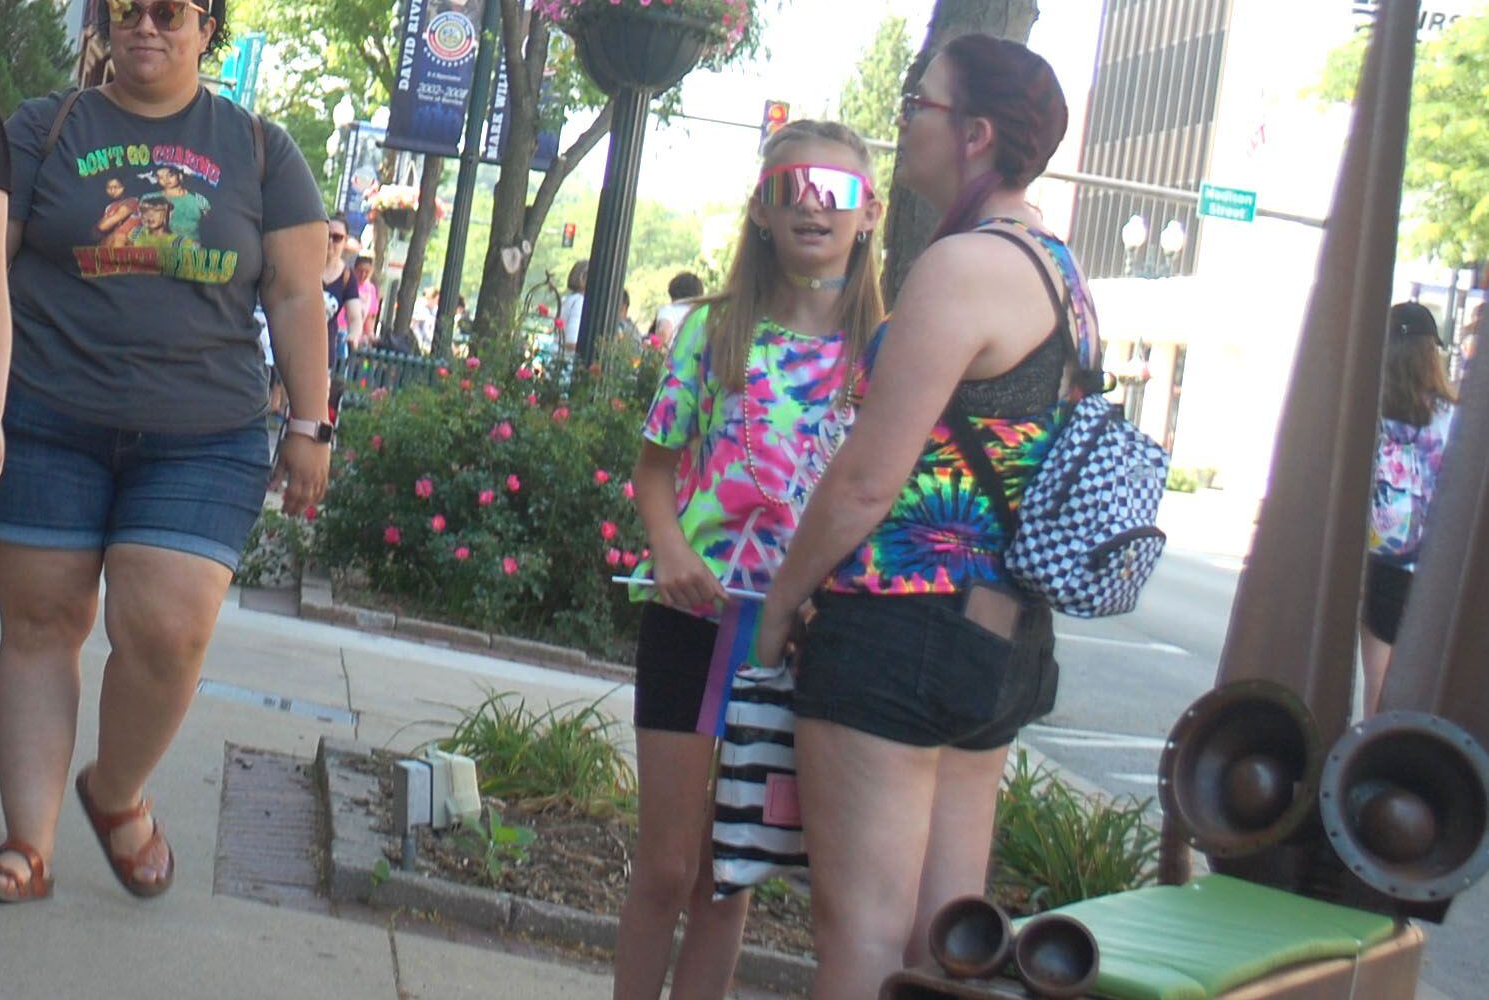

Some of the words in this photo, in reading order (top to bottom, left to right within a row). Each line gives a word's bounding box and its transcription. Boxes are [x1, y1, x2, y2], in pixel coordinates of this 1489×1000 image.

[398, 36, 417, 91] DAVID
[76, 145, 124, 177] DON'T
[127, 143, 151, 166] GO
[487, 112, 504, 160] MARK
